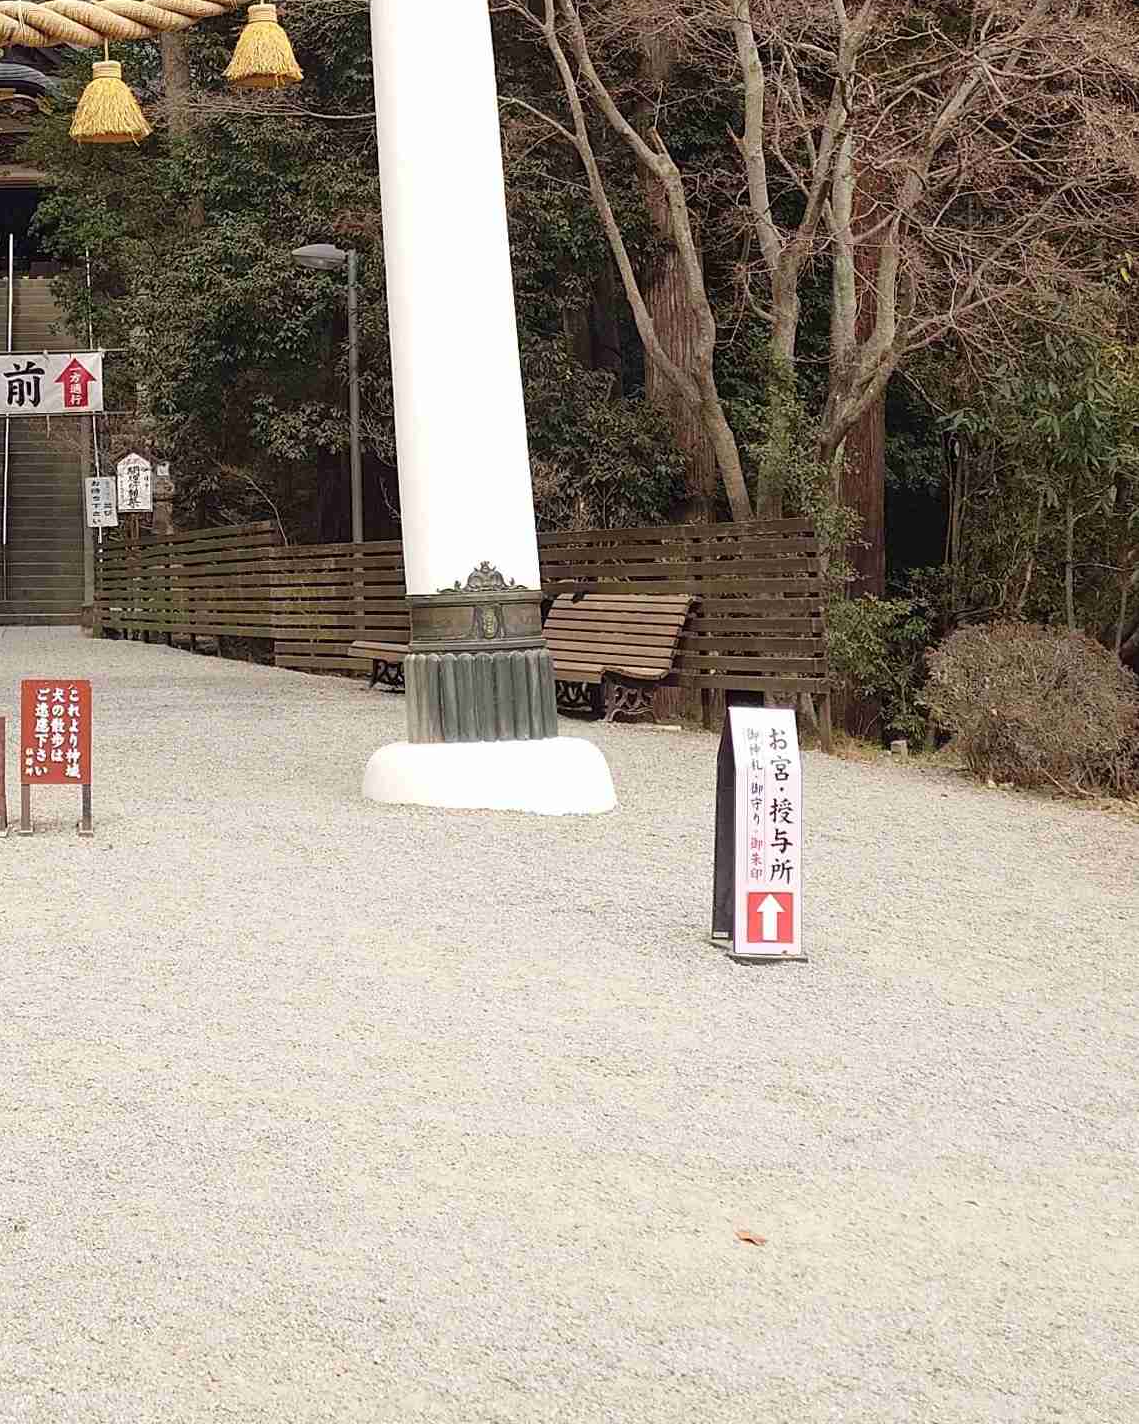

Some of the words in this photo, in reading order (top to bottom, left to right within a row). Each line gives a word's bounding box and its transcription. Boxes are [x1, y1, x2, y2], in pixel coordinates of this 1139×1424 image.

[50, 687, 65, 763] 犬の散歩は
[769, 727, 795, 885] お宮・授与所
